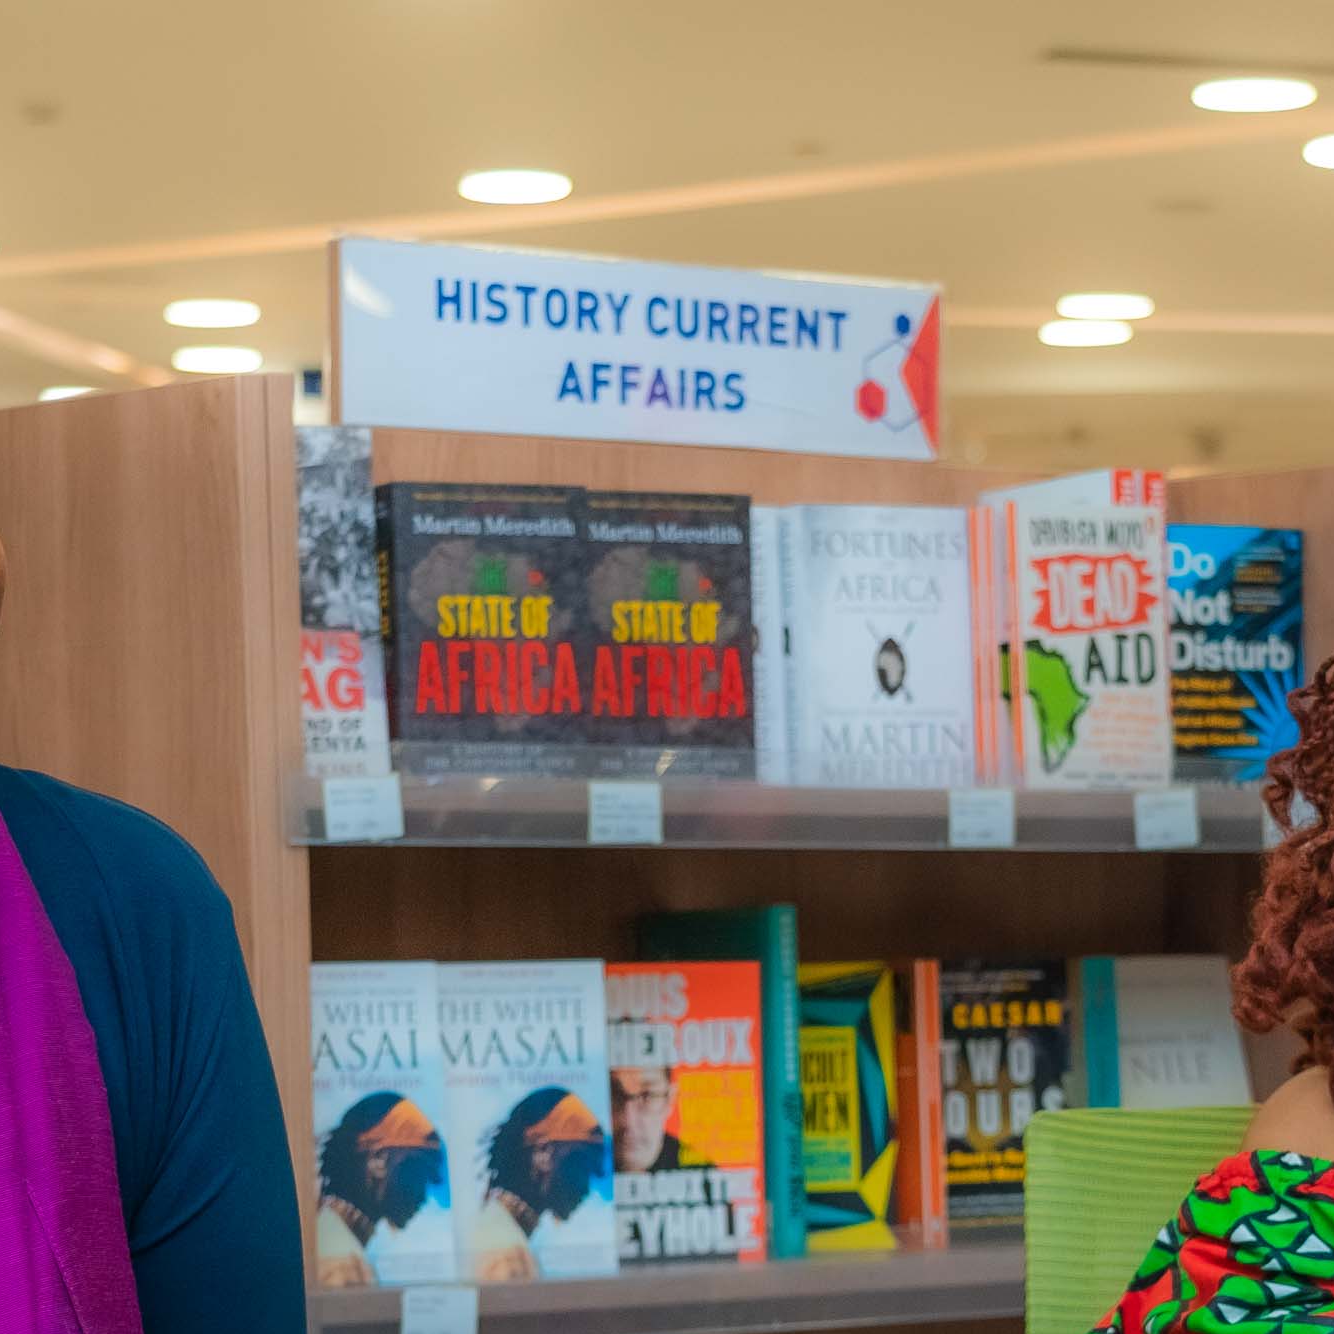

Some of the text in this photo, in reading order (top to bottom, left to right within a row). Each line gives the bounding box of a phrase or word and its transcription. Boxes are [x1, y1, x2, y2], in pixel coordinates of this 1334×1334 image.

[436, 277, 849, 352] HISTORY CURRENT
[557, 360, 747, 412] AFFAIRS
[810, 530, 964, 559] FORTUNES
[1168, 543, 1215, 579] Do
[834, 575, 943, 603] AFRICA
[1048, 560, 1141, 629] DEAD
[1168, 589, 1231, 626] Not
[437, 594, 553, 639] STATE OF
[611, 600, 722, 645] STATE OF
[302, 633, 364, 665] N'S
[1083, 632, 1157, 687] AID
[1170, 632, 1295, 672] Disturb
[301, 668, 365, 711] AG
[415, 641, 582, 716] AFRICA
[592, 645, 747, 718] AFRICA
[305, 736, 367, 753] ENYA
[820, 721, 967, 755] MARTIN
[323, 1000, 418, 1025] WHITE
[436, 998, 585, 1024] THE WHITE
[607, 970, 689, 1020] OUIS
[952, 1000, 1063, 1029] CAESAR
[312, 1028, 419, 1072] ASAI
[438, 1025, 585, 1068] MASAI
[608, 1017, 753, 1069] HEROUX
[940, 1037, 1035, 1086] TWO
[944, 1086, 1066, 1138] OURS
[615, 1203, 758, 1257] EYHOLE
